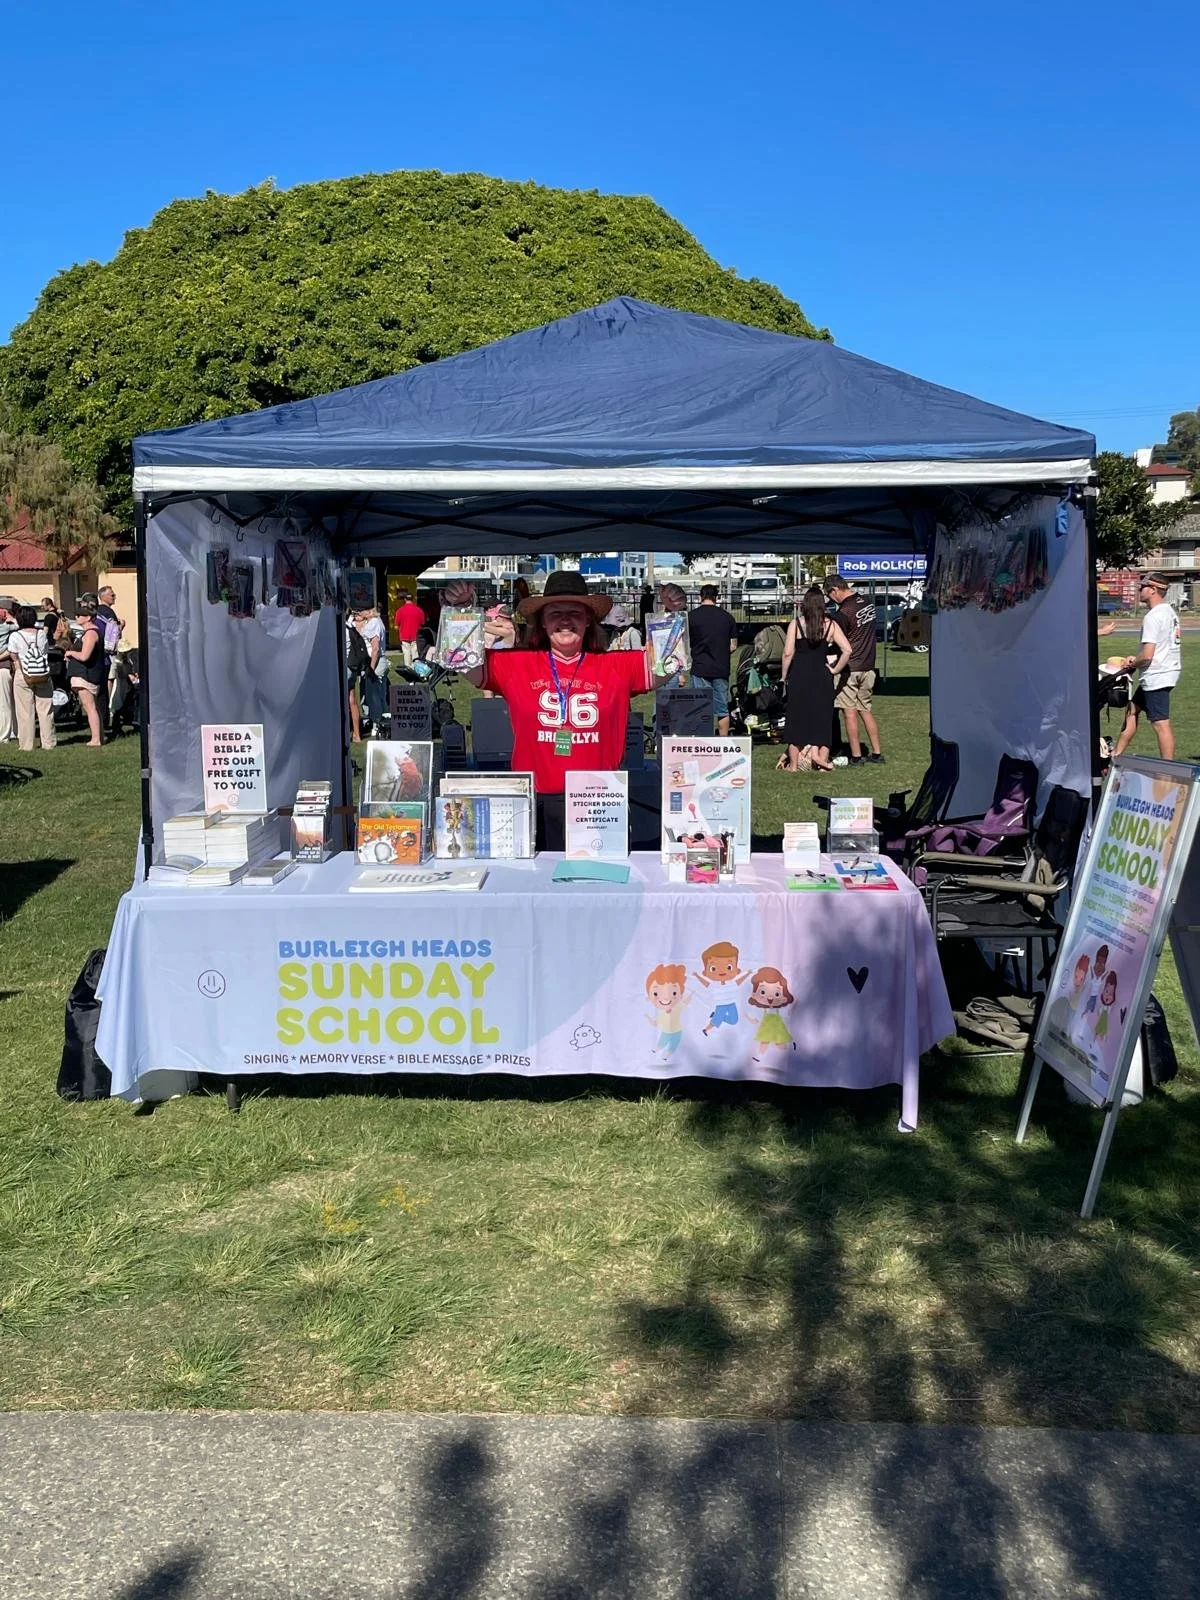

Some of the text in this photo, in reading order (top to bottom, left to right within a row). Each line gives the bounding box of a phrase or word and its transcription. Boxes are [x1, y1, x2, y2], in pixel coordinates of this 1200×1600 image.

[843, 561, 867, 570] Rob
[537, 689, 599, 729] 96
[213, 733, 242, 741] NEED
[537, 730, 599, 744] BRKLYN
[214, 745, 252, 753] BIBLE?
[207, 769, 261, 777] FREE GIFT
[230, 781, 257, 790] YOU.
[1116, 794, 1175, 822] BURLEIGH HEADS
[1108, 810, 1171, 853] SUNDAY
[1097, 841, 1158, 889] SCHOOL
[278, 939, 492, 959] BURLEIGH HEADS
[277, 962, 495, 1001] SUNDAY
[276, 1006, 500, 1046] SCHOOL
[243, 1053, 531, 1067] SINGING MEMORY VERSE BIBLE MESSAGE PRIZES
